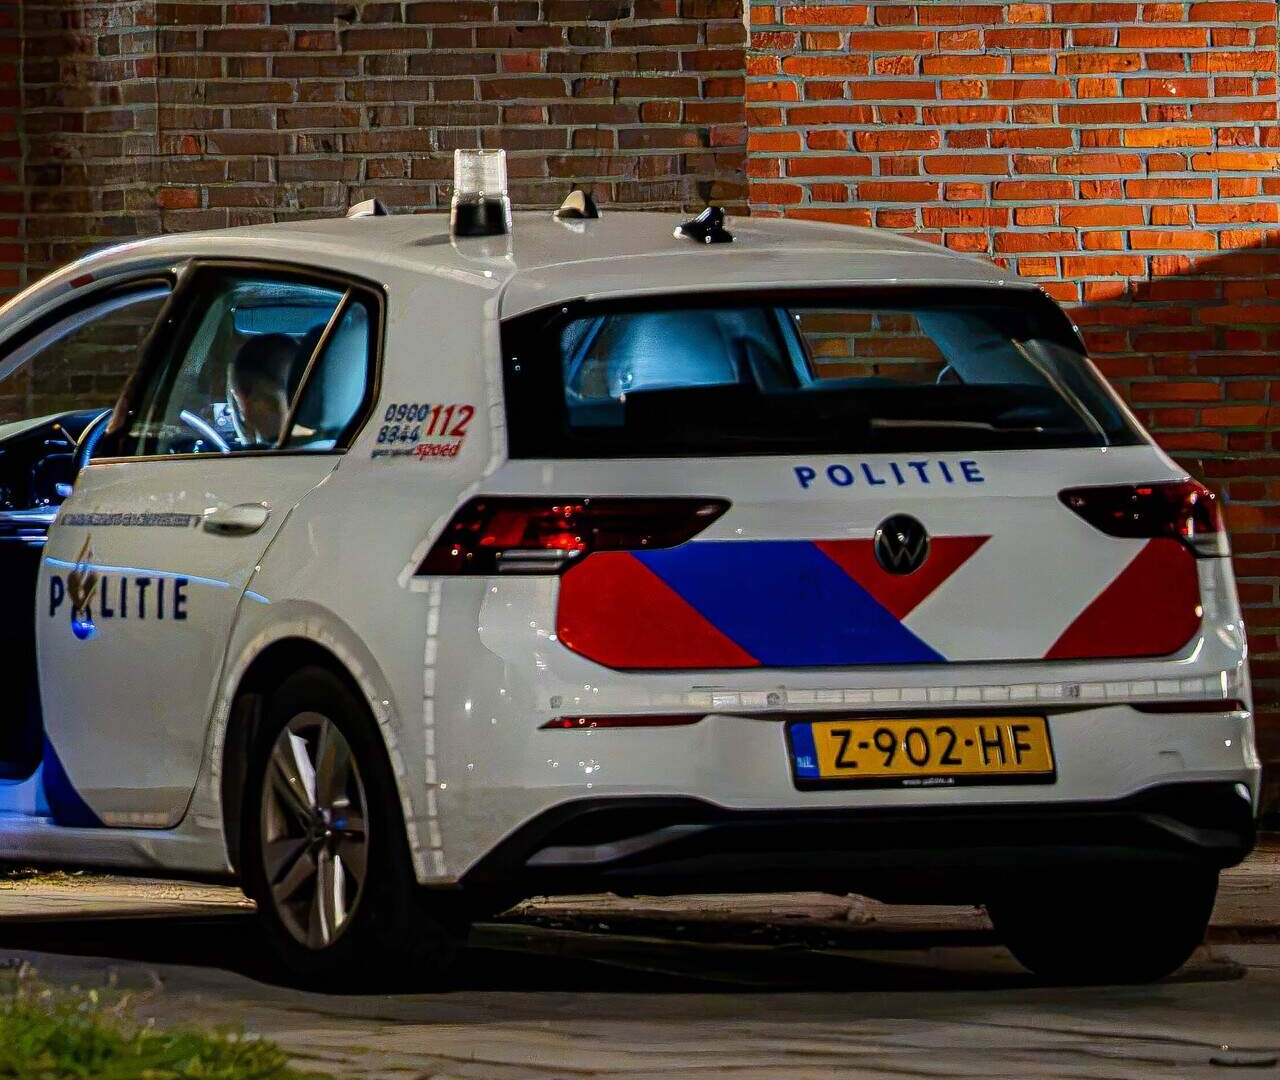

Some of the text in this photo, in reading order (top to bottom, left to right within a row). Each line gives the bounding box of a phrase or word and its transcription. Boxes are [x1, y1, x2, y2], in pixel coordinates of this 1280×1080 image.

[426, 403, 475, 436] 112
[793, 460, 985, 489] POLITIE
[49, 574, 189, 622] POLITIE
[830, 724, 1032, 770] Z-902-HF
